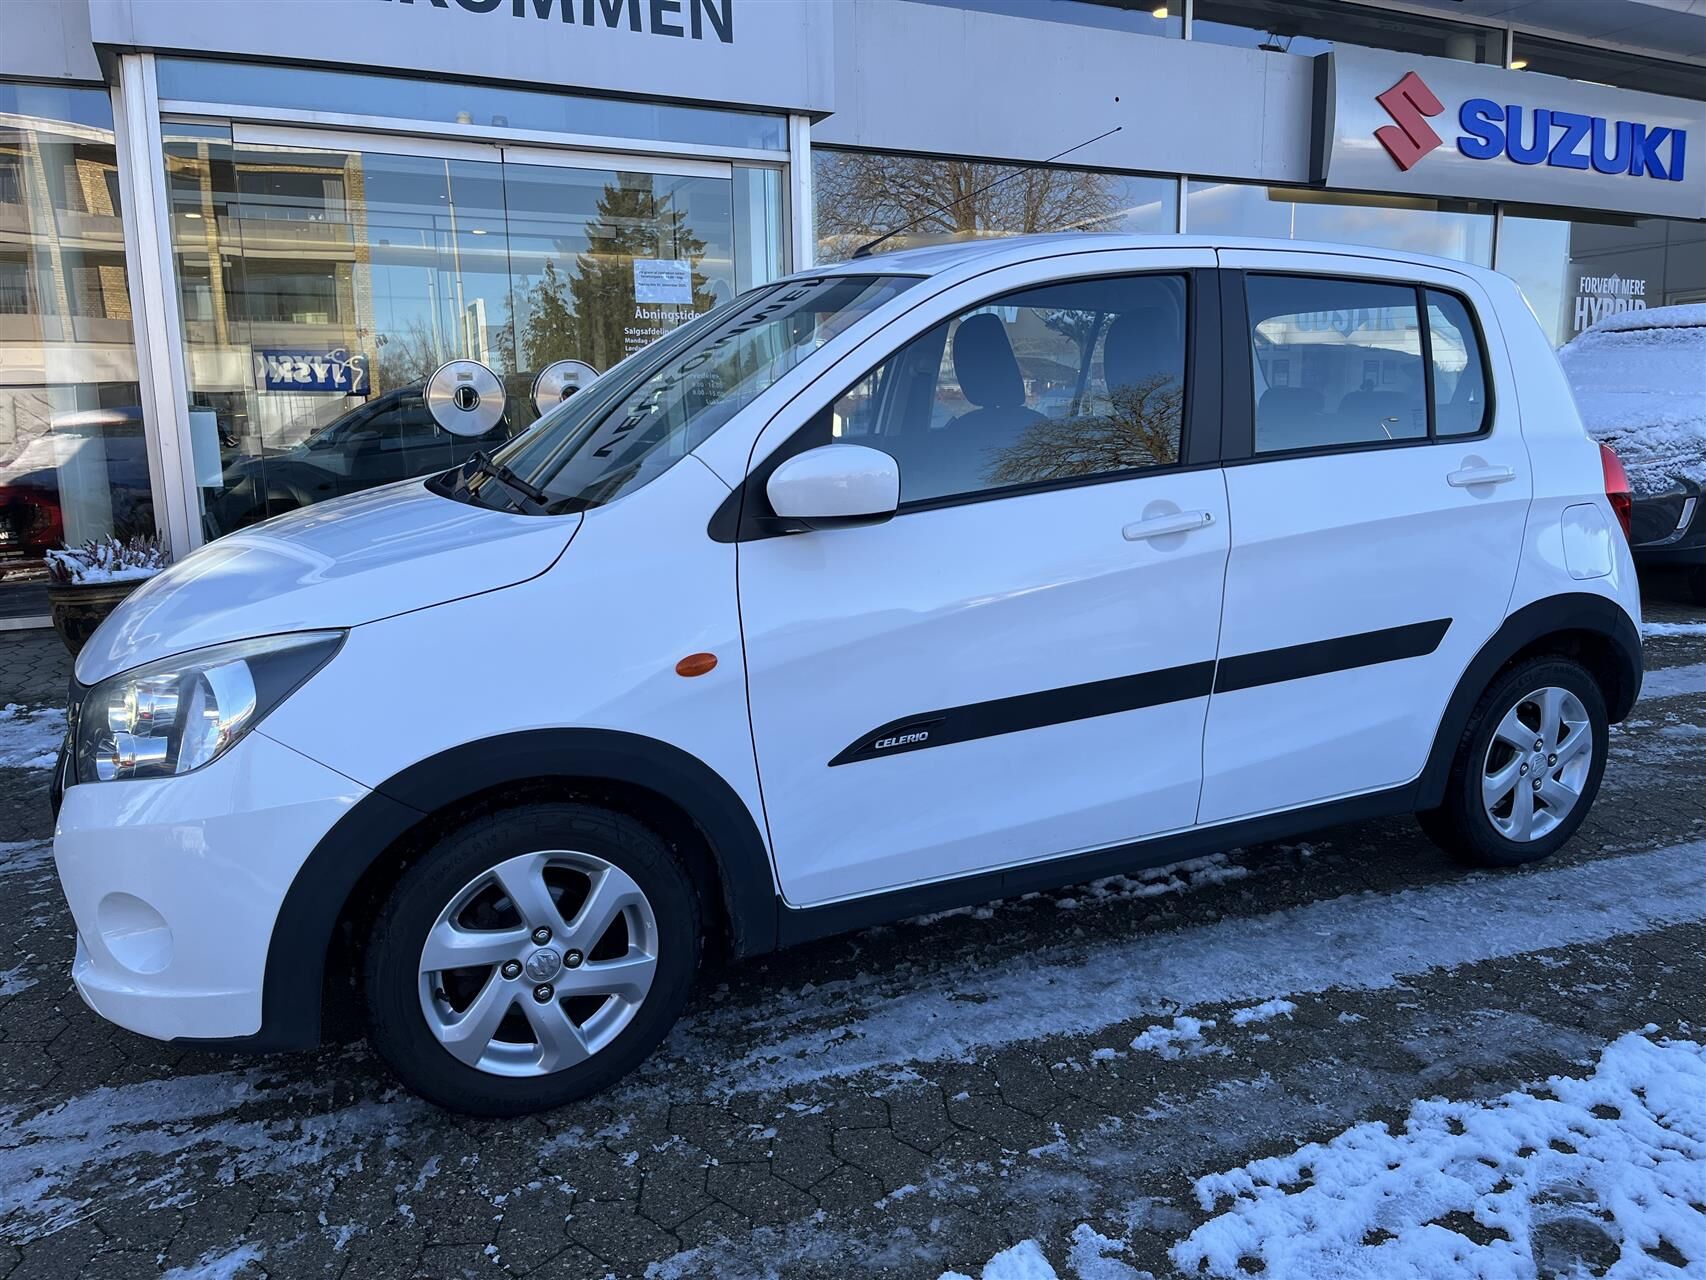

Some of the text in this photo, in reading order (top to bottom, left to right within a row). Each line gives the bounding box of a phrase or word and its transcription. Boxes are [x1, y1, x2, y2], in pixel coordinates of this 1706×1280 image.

[1456, 98, 1687, 181] SUZUKI
[1580, 276, 1646, 295] FORVENT MERE
[634, 306, 704, 321] Åbningstide
[624, 327, 673, 337] Salgsafdelin
[874, 731, 929, 749] CELERIO
